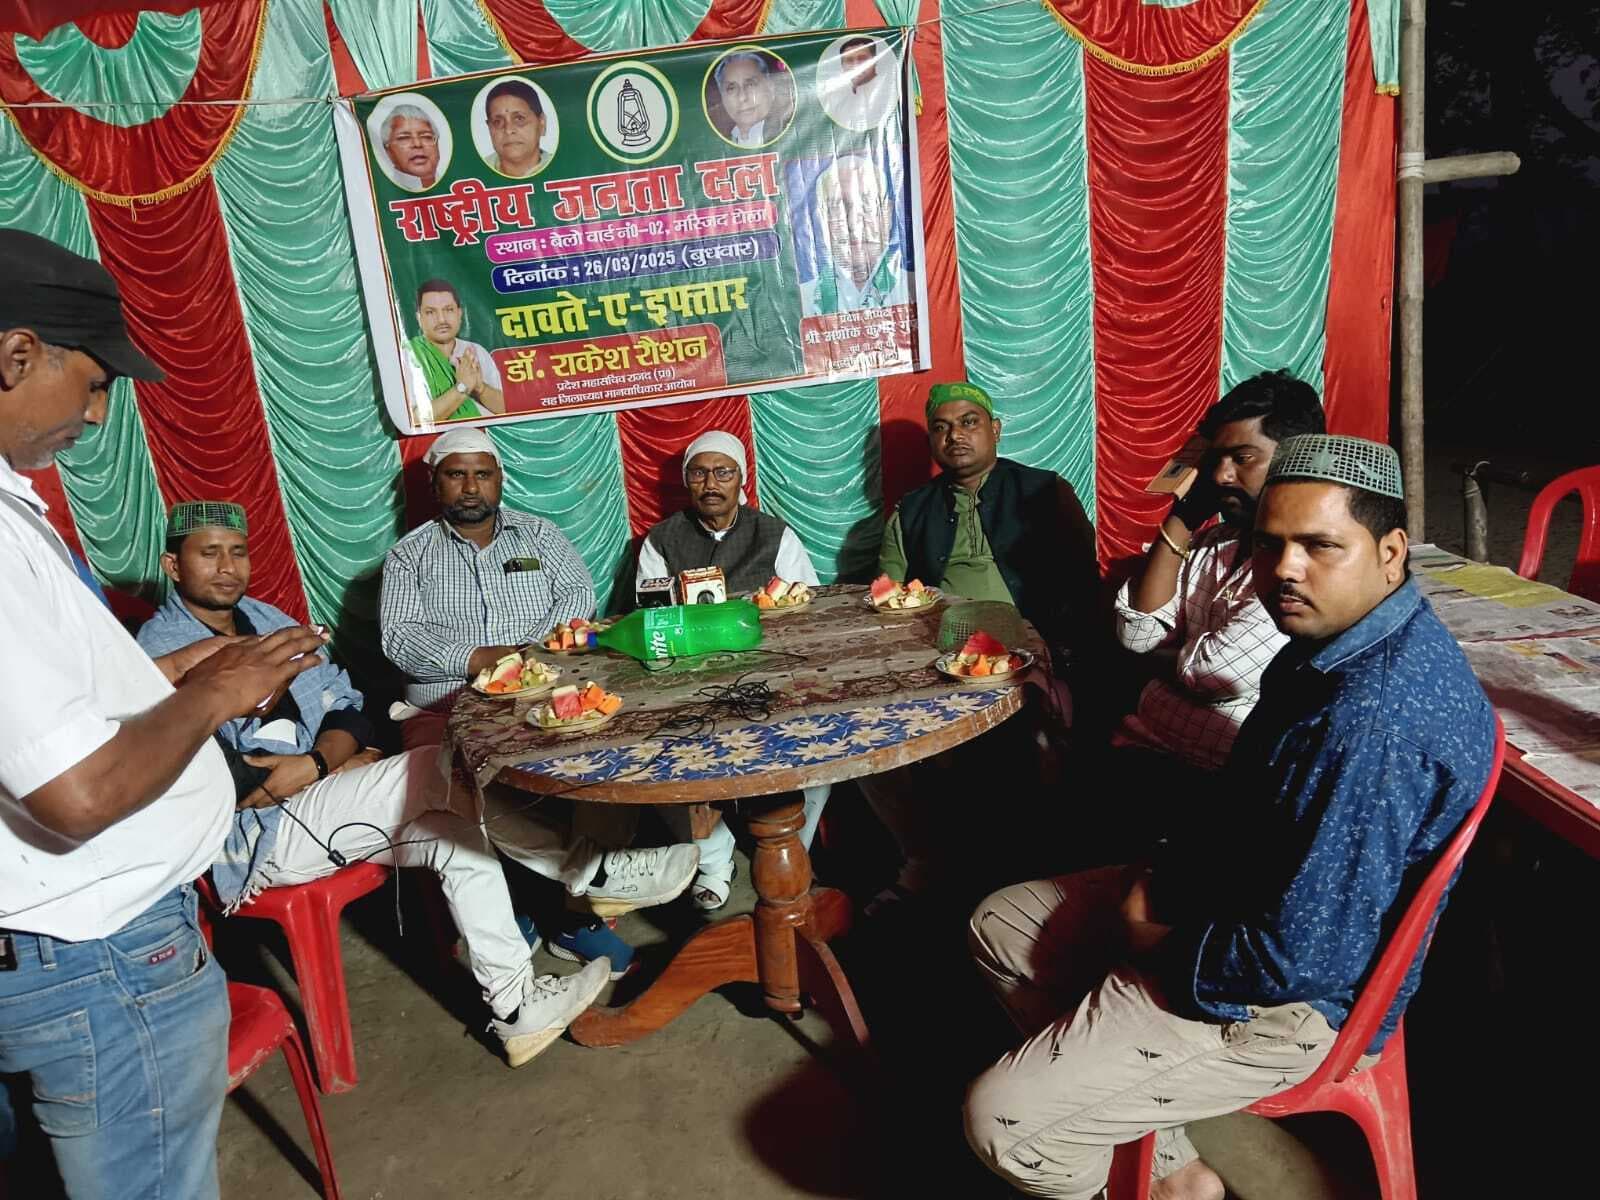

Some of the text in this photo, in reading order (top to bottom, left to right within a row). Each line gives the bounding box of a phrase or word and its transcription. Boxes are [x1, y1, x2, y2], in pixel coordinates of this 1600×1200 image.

[389, 154, 780, 246] राष्ट्रीय जनता दल
[494, 238, 536, 255] स्थान
[585, 224, 615, 242] वार्ड
[673, 213, 729, 232] मस्जिद
[503, 263, 568, 286] दिनांक
[584, 250, 676, 277] 26/03/2025
[682, 236, 759, 269] (बुधवार)
[504, 350, 545, 383] डॉ.
[551, 344, 631, 377] राकेश
